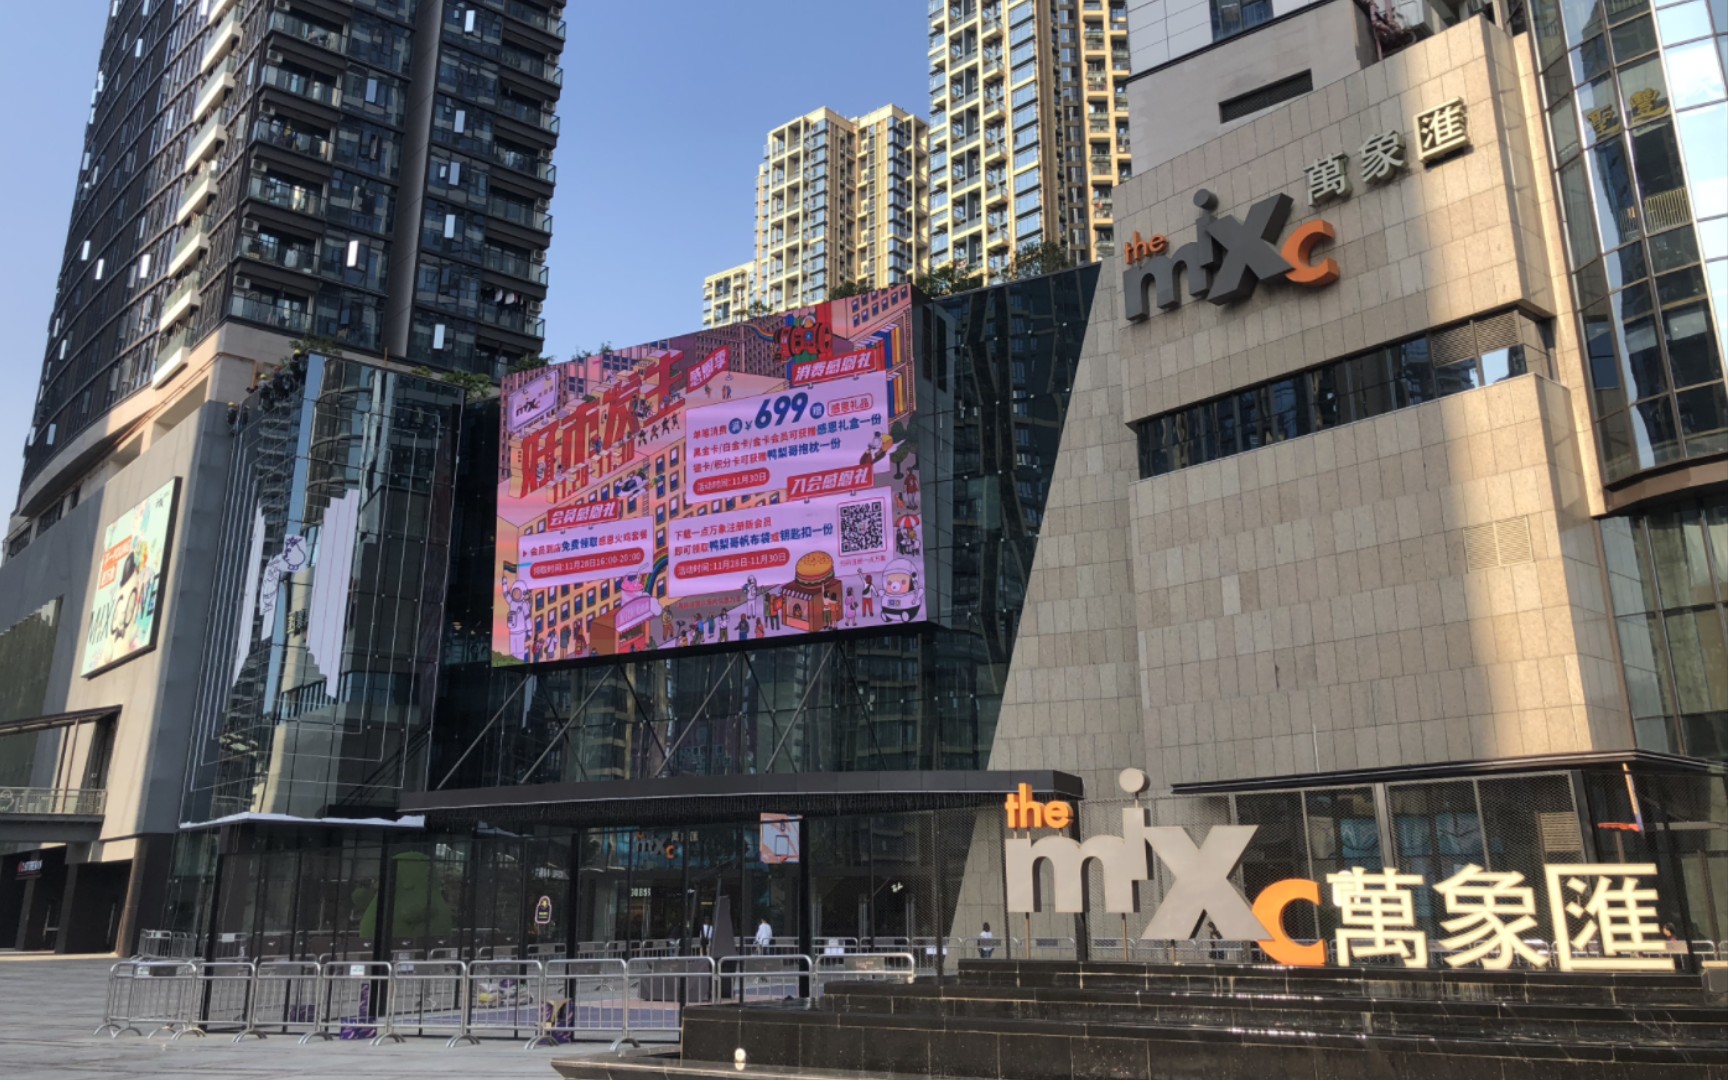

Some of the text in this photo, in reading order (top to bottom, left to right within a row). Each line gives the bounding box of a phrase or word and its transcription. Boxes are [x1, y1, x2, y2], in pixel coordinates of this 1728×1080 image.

[1304, 97, 1471, 206] 萬象匯
[1123, 230, 1168, 264] the
[795, 351, 871, 381] 消费感恩礼
[831, 398, 870, 415] 感恩礼品
[790, 467, 868, 496] 入会感恩礼
[549, 501, 616, 526] 会员感恩礼
[674, 516, 772, 541] 下载一点万象注册新会员
[1004, 783, 1073, 828] the
[1326, 863, 1675, 972] 萬象匯
